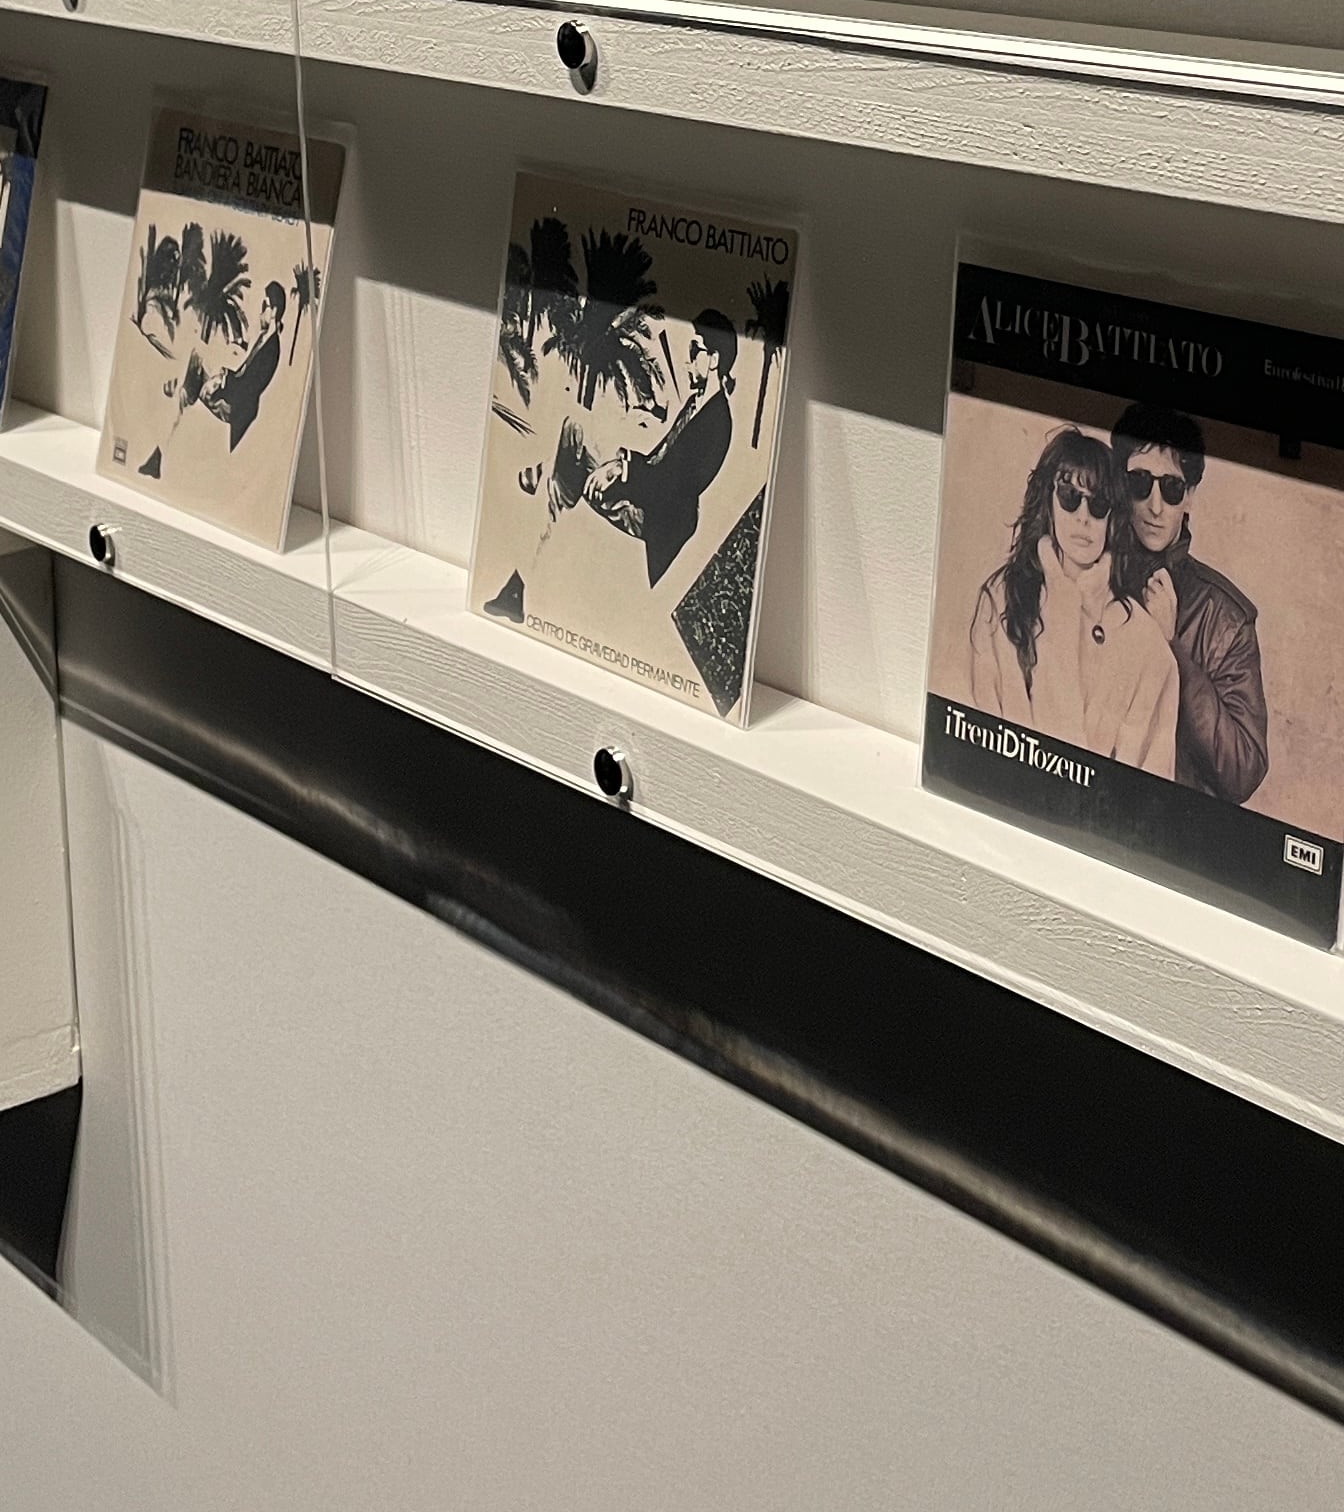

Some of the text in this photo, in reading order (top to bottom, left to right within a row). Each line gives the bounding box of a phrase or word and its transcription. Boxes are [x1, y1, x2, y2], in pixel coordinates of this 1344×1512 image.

[177, 127, 239, 166] FRANCO
[627, 207, 789, 265] FRANCO BATTIATO
[526, 614, 701, 699] CENTRO DE GRAVEDAD PERMANENTE
[1290, 844, 1317, 867] EMI
